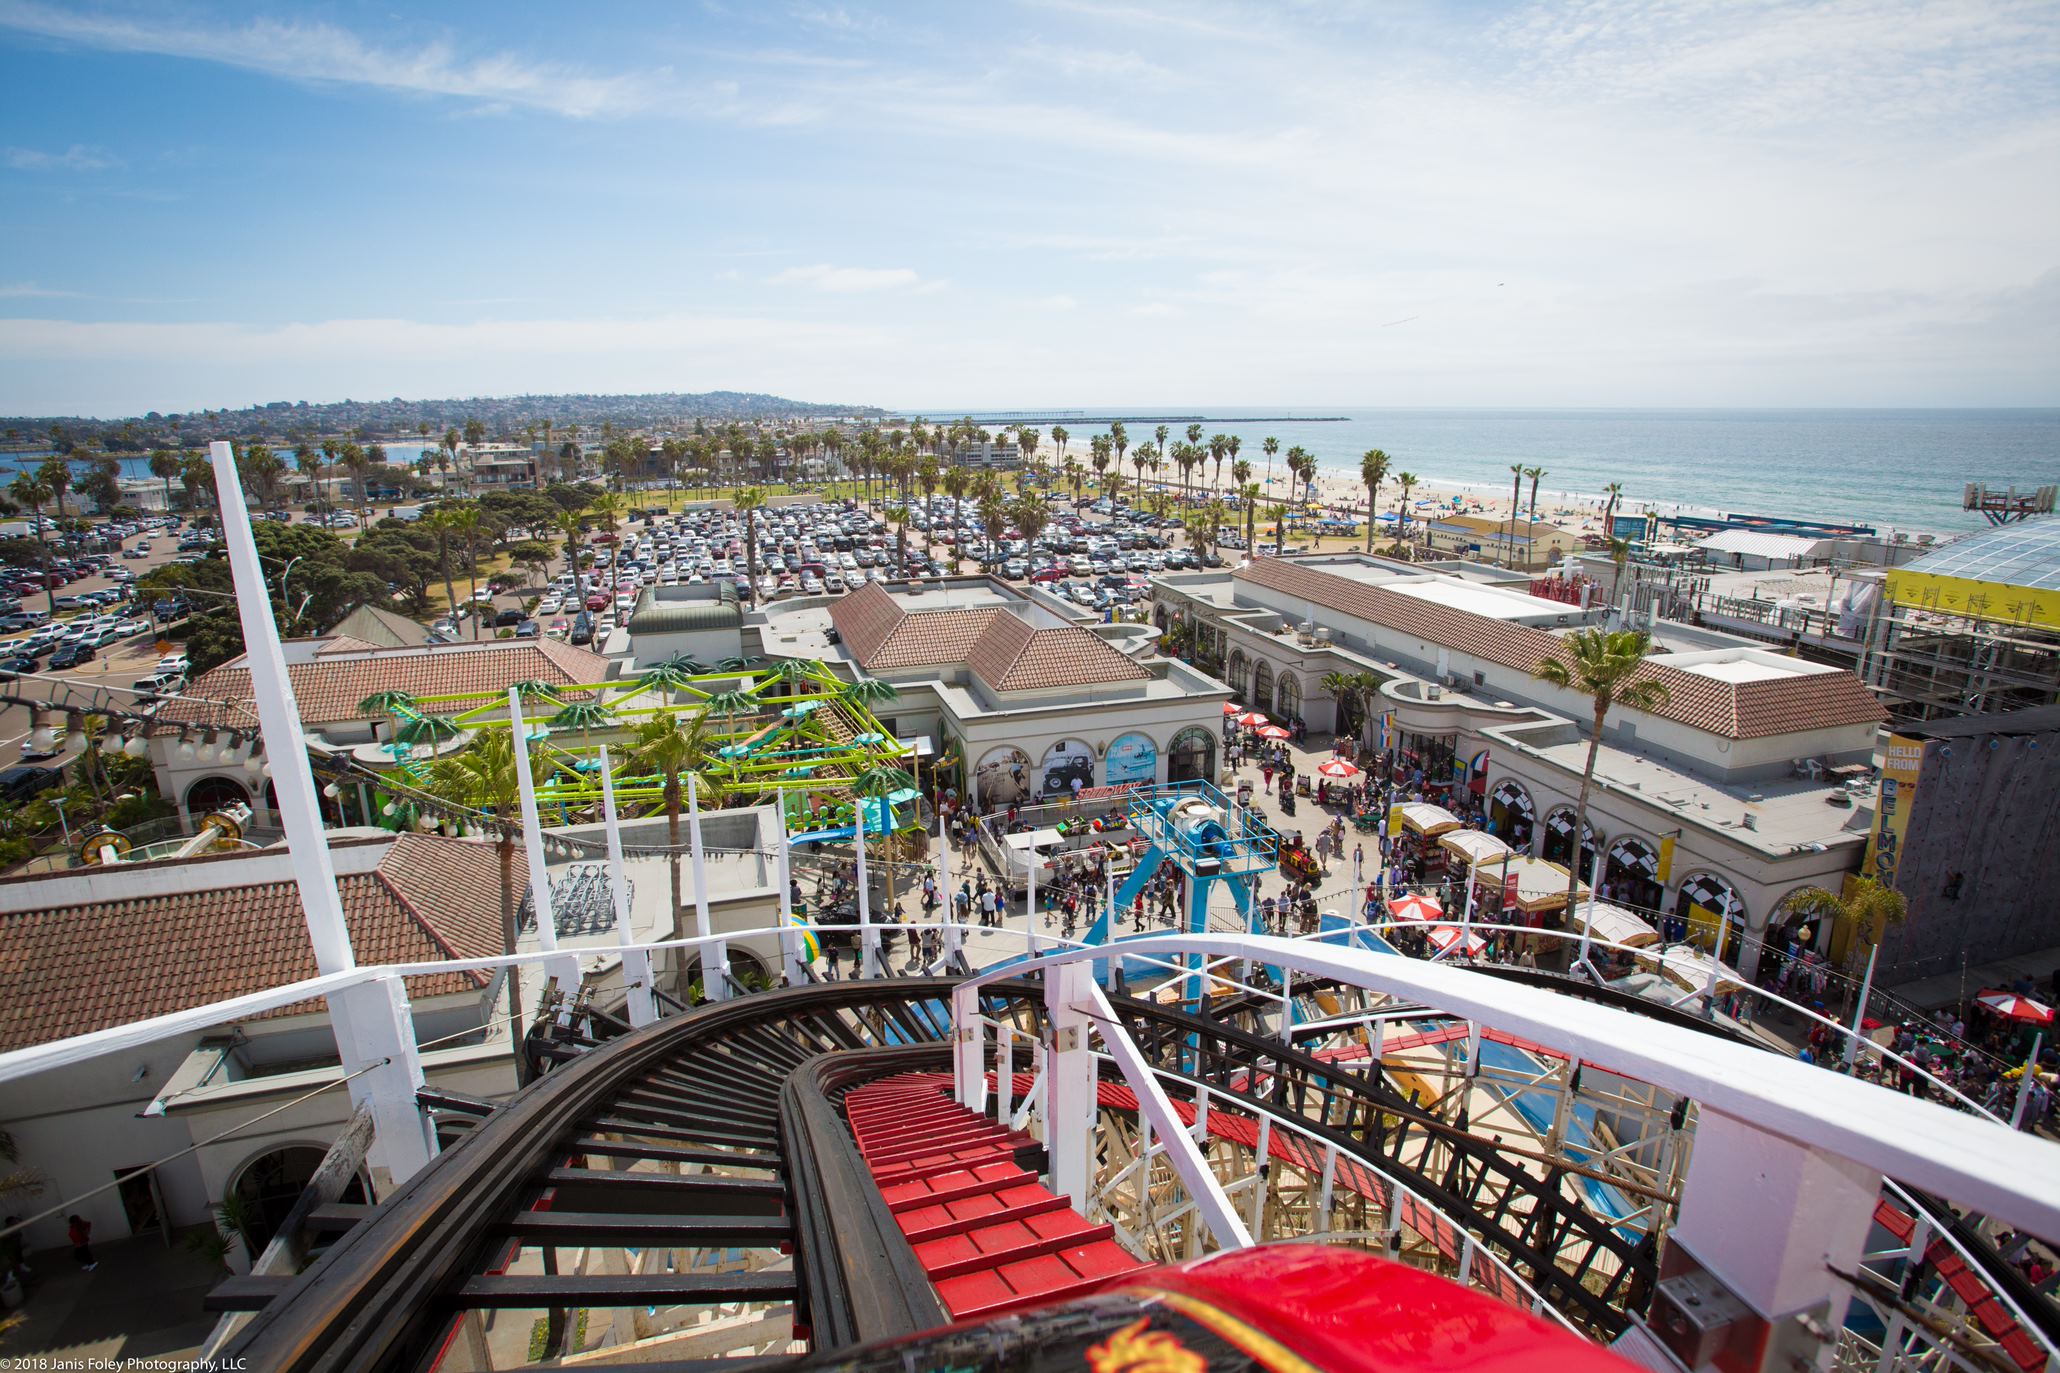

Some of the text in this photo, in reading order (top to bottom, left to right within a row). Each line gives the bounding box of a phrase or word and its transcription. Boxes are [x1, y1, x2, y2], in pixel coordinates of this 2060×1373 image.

[1888, 746, 1921, 758] HELLO
[1887, 758, 1920, 771] FROM
[1876, 778, 1898, 889] BELMON
